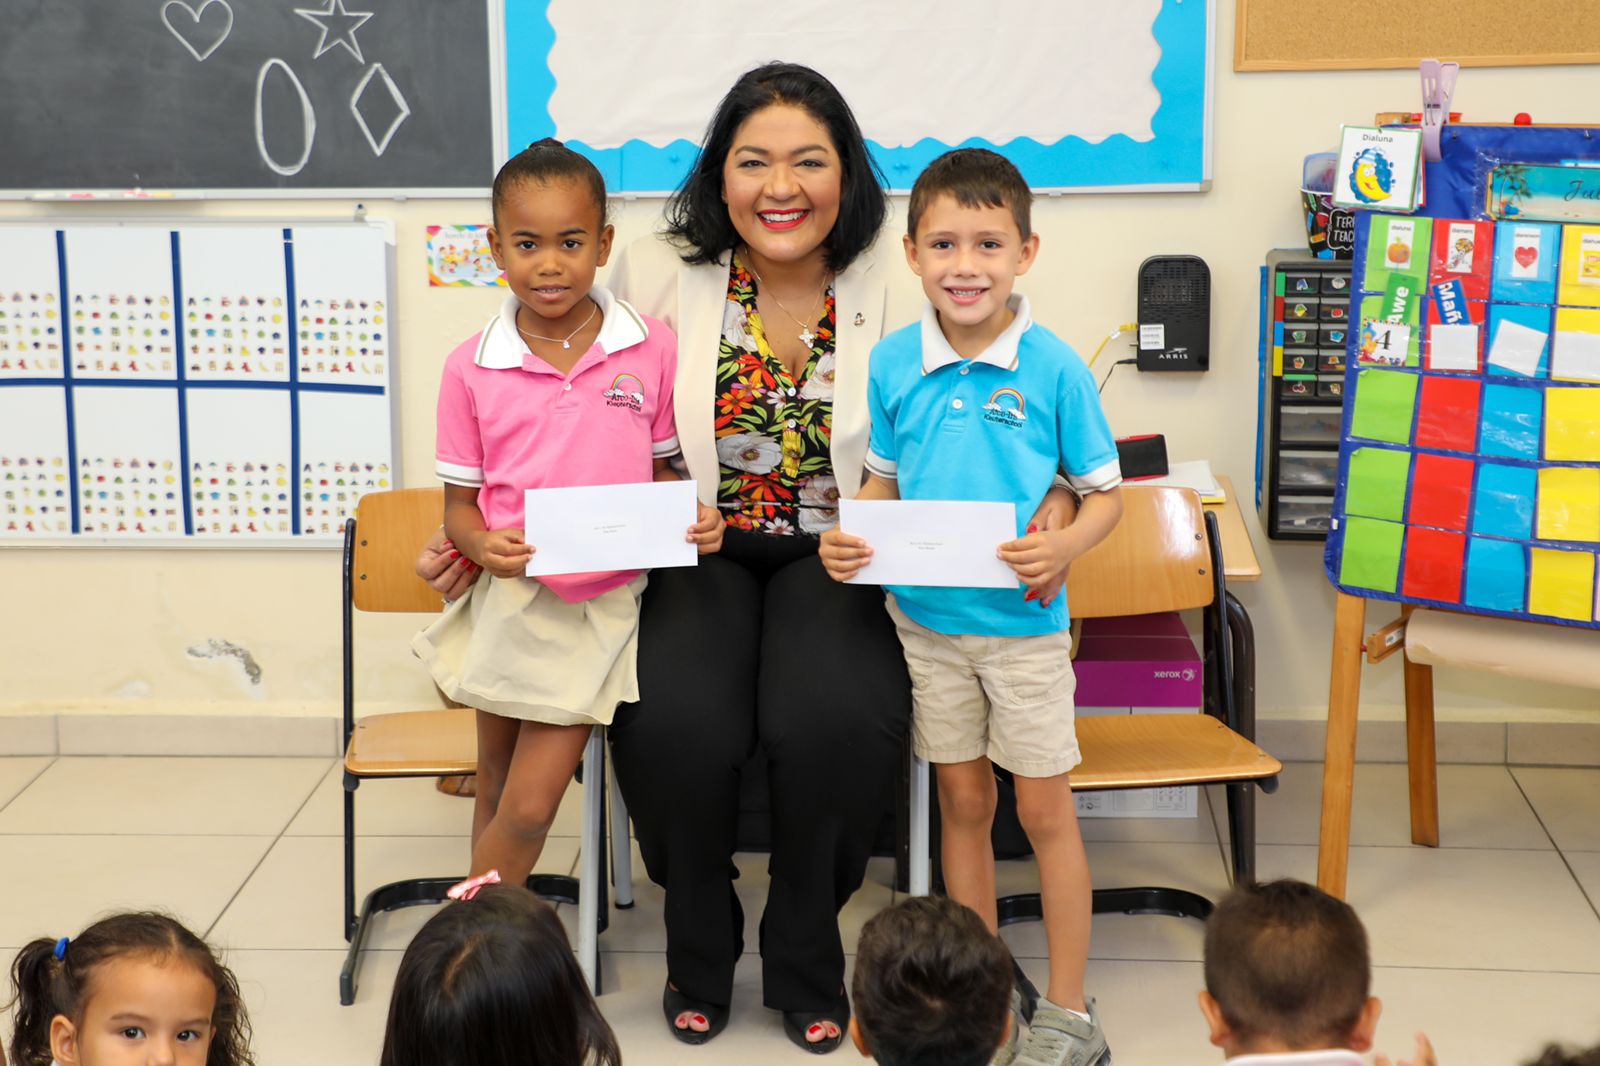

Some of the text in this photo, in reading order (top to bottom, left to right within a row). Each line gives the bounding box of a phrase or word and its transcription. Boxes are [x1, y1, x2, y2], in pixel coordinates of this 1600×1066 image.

[1362, 133, 1393, 143] Dialuna
[1439, 281, 1462, 324] Mañ
[1376, 330, 1392, 350] 4
[1153, 670, 1181, 679] xerox
